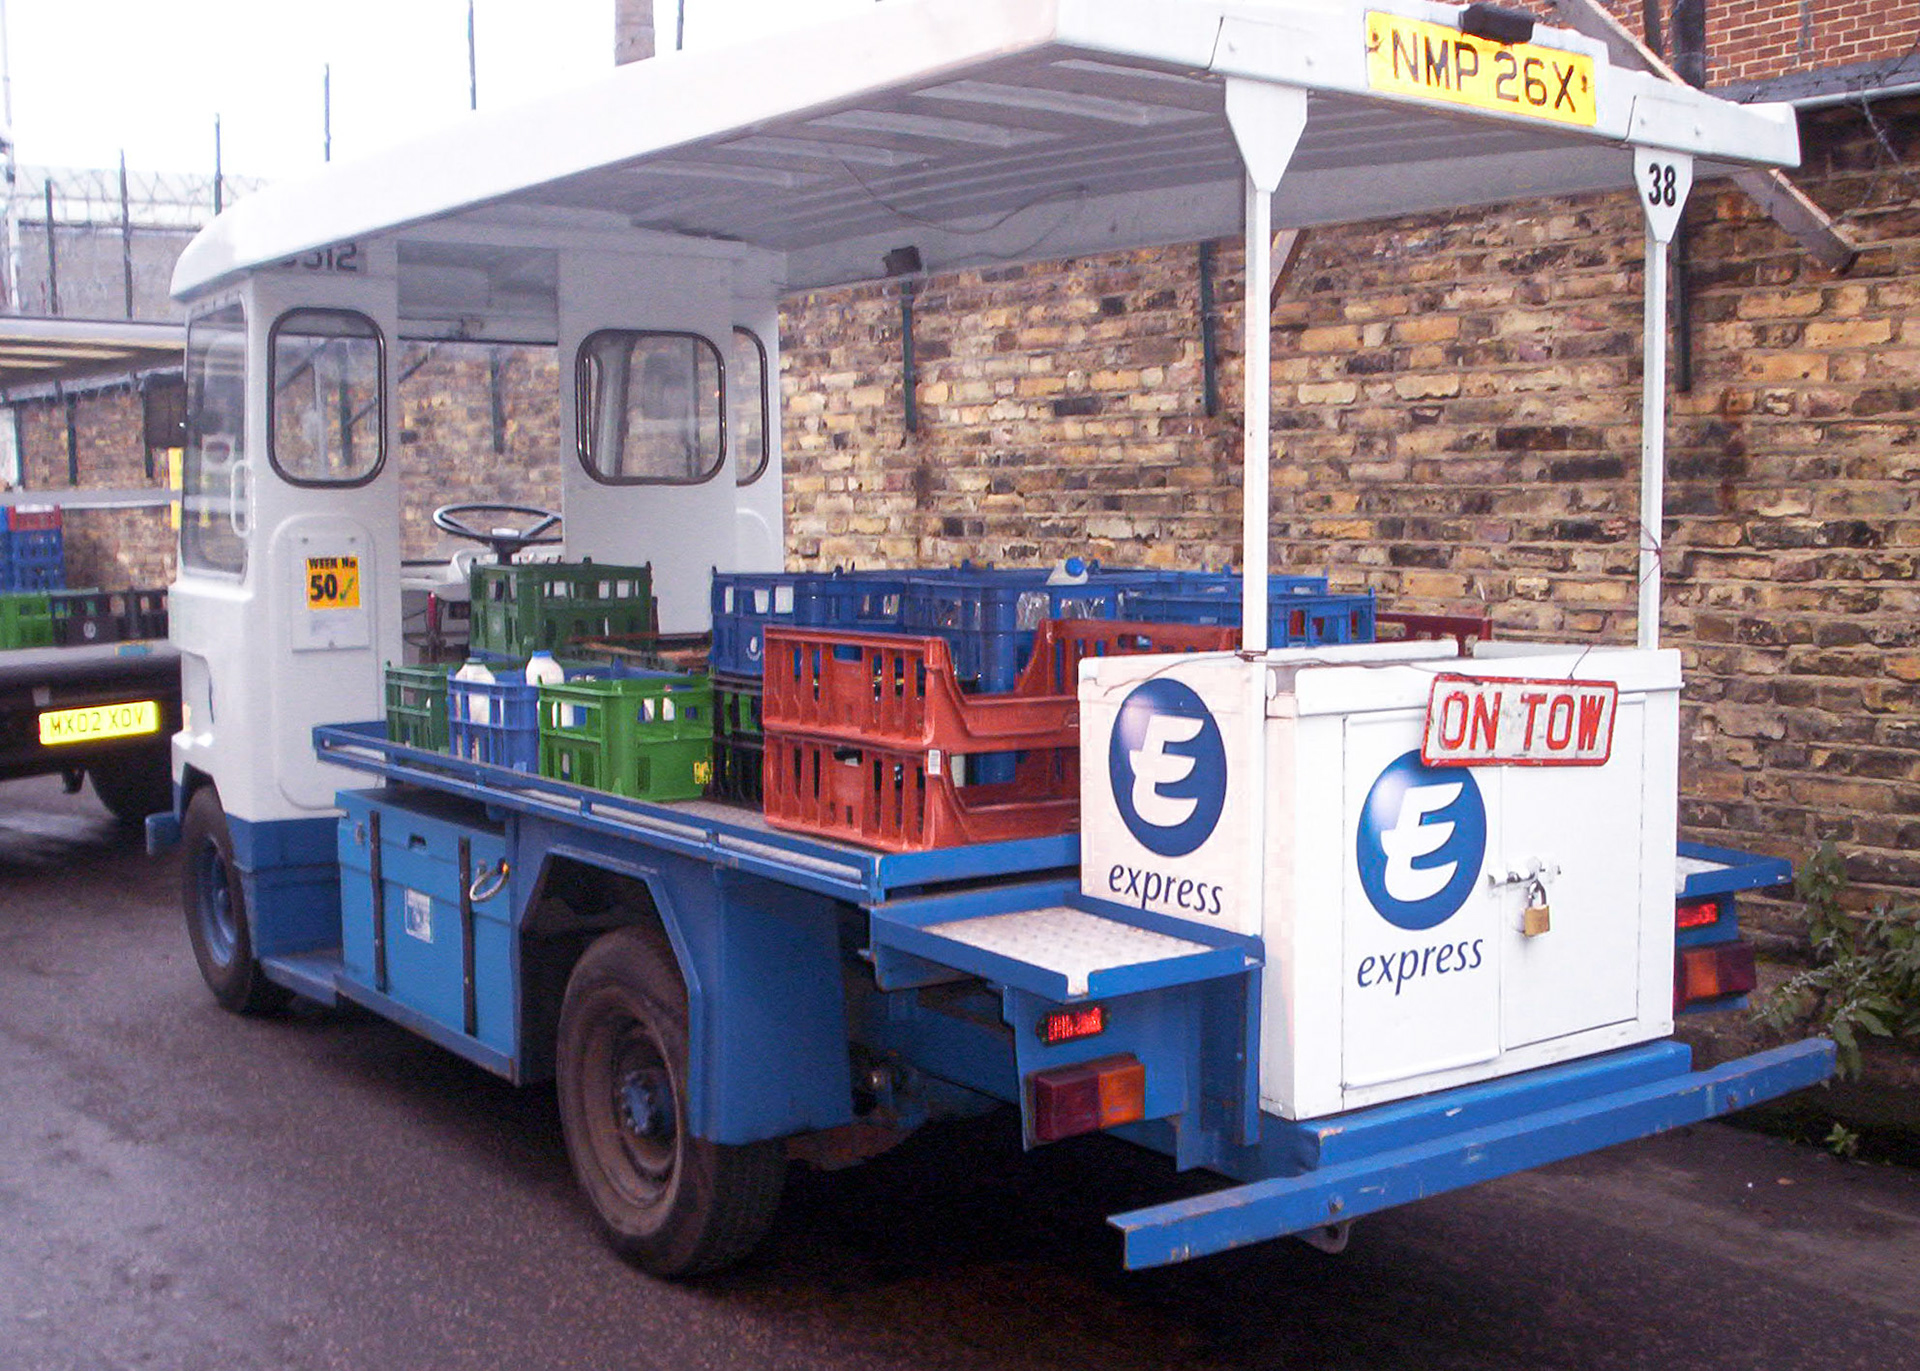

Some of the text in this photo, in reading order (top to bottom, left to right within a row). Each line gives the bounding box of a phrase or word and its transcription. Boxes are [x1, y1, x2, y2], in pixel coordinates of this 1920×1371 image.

[1391, 28, 1576, 113] NMP 26X
[1647, 162, 1677, 207] 38
[309, 573, 338, 602] 50
[1440, 690, 1606, 751] ON TOW
[1108, 863, 1224, 916] express
[1356, 937, 1484, 996] express
